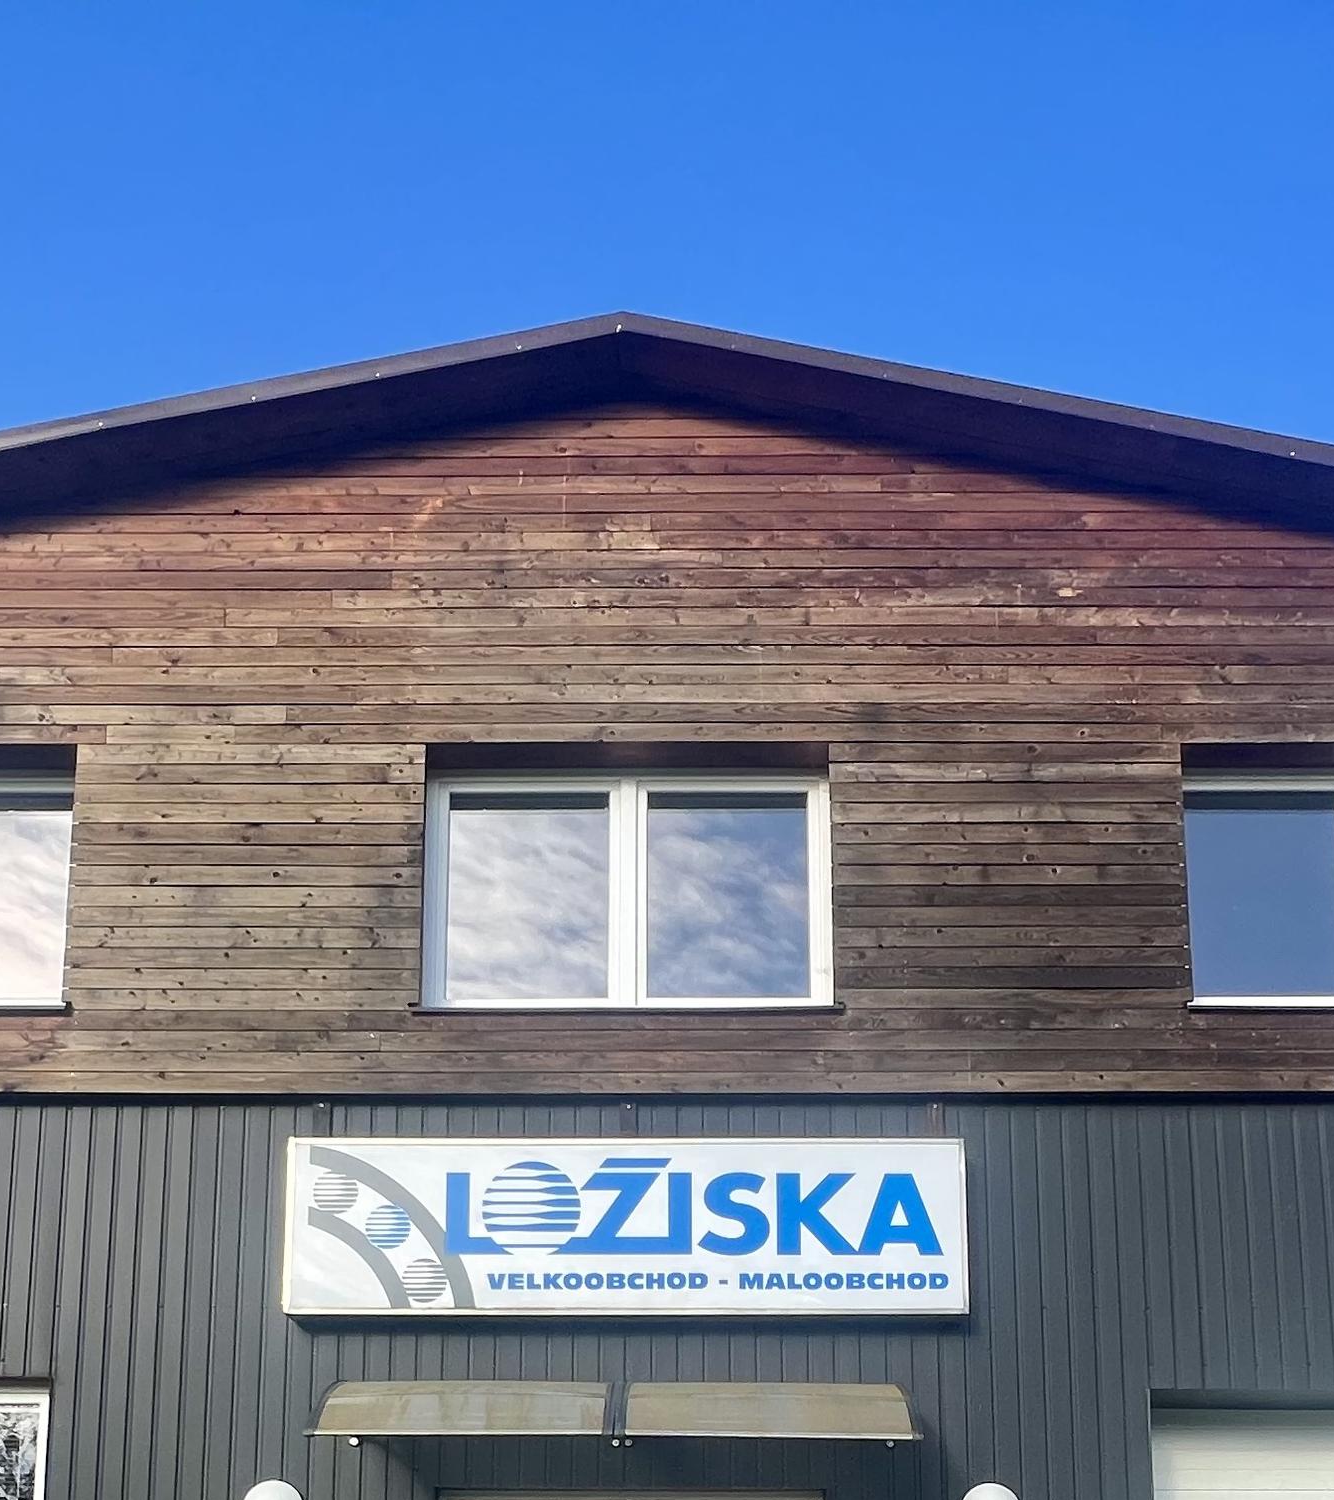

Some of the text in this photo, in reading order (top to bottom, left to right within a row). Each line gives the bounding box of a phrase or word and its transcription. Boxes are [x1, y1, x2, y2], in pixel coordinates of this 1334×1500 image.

[445, 1157, 944, 1256] LOŽISKA
[487, 1272, 709, 1290] VELKOOBCHOD
[738, 1272, 950, 1290] MALOOBCHOD
